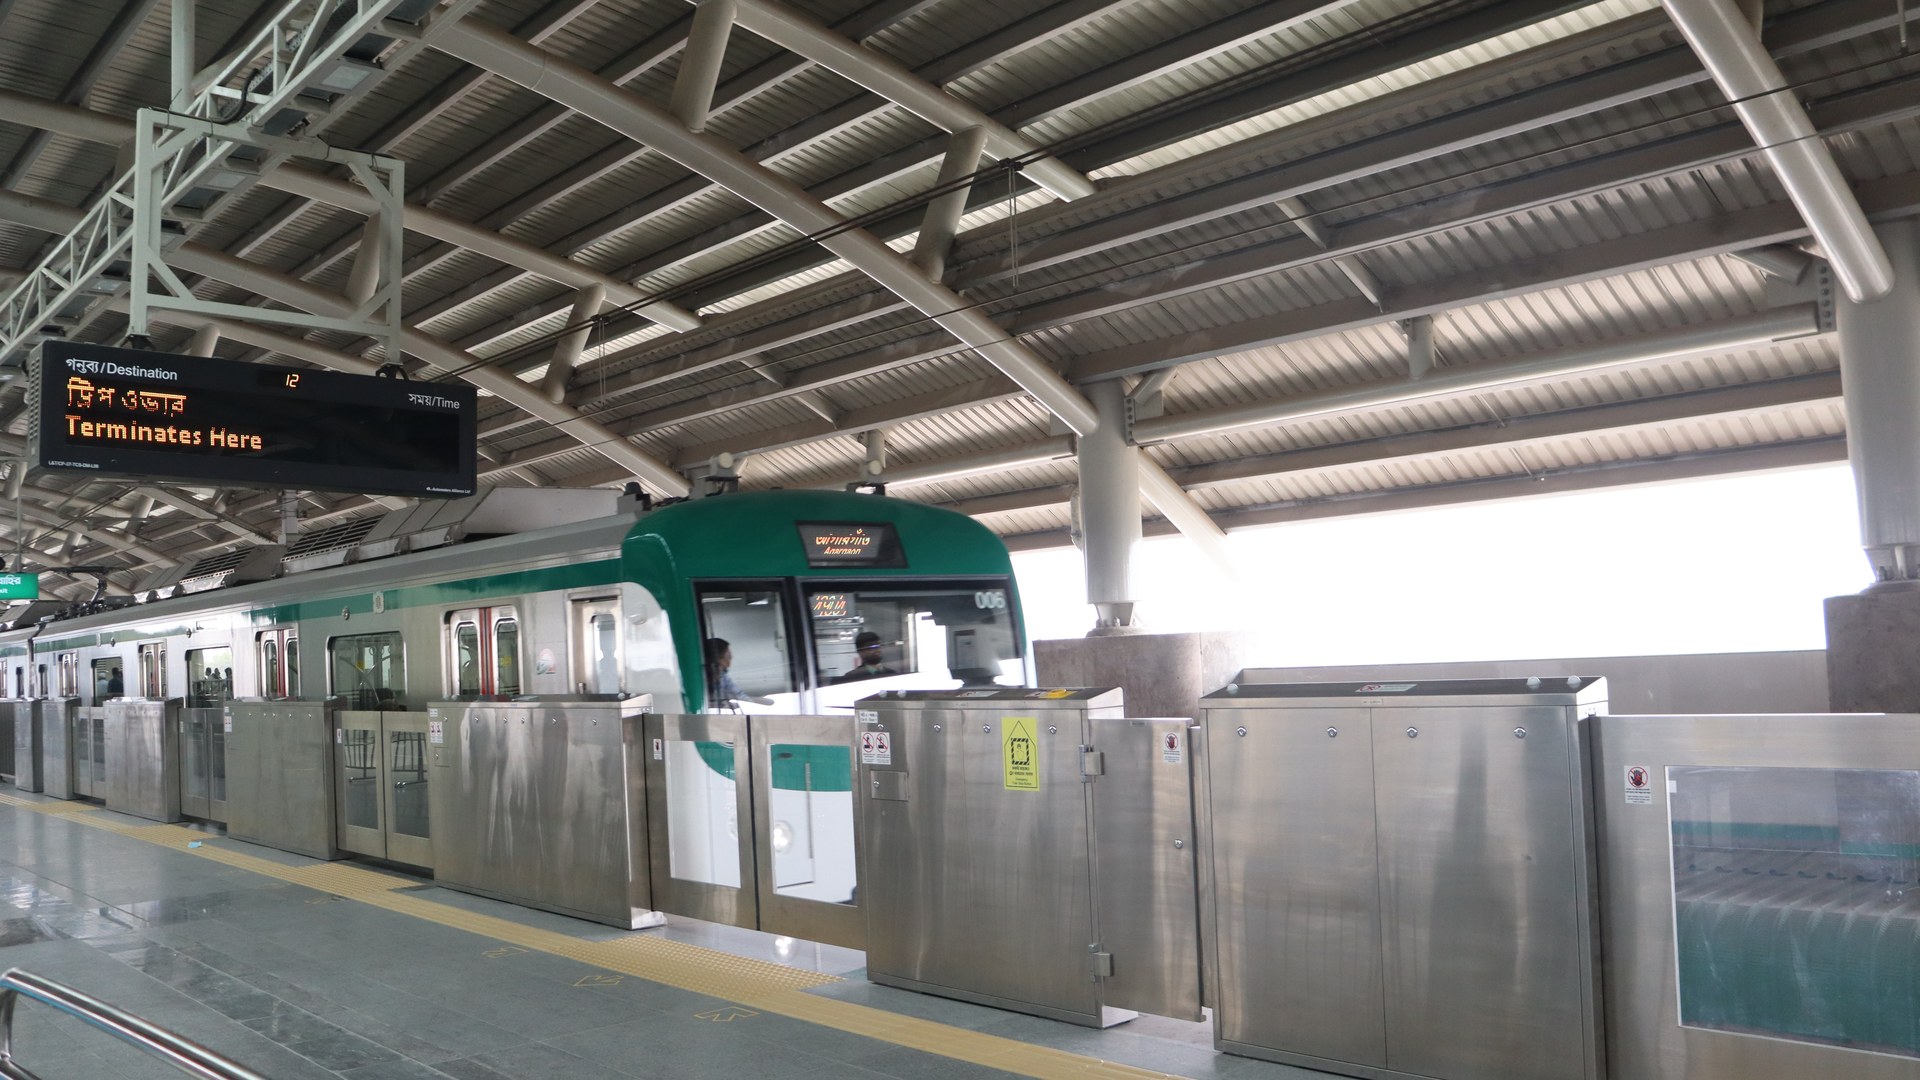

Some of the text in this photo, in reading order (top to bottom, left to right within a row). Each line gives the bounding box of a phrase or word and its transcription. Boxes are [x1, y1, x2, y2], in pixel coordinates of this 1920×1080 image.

[286, 374, 299, 388] 12
[65, 415, 262, 450] Terminates Here
[975, 591, 1006, 610] 006
